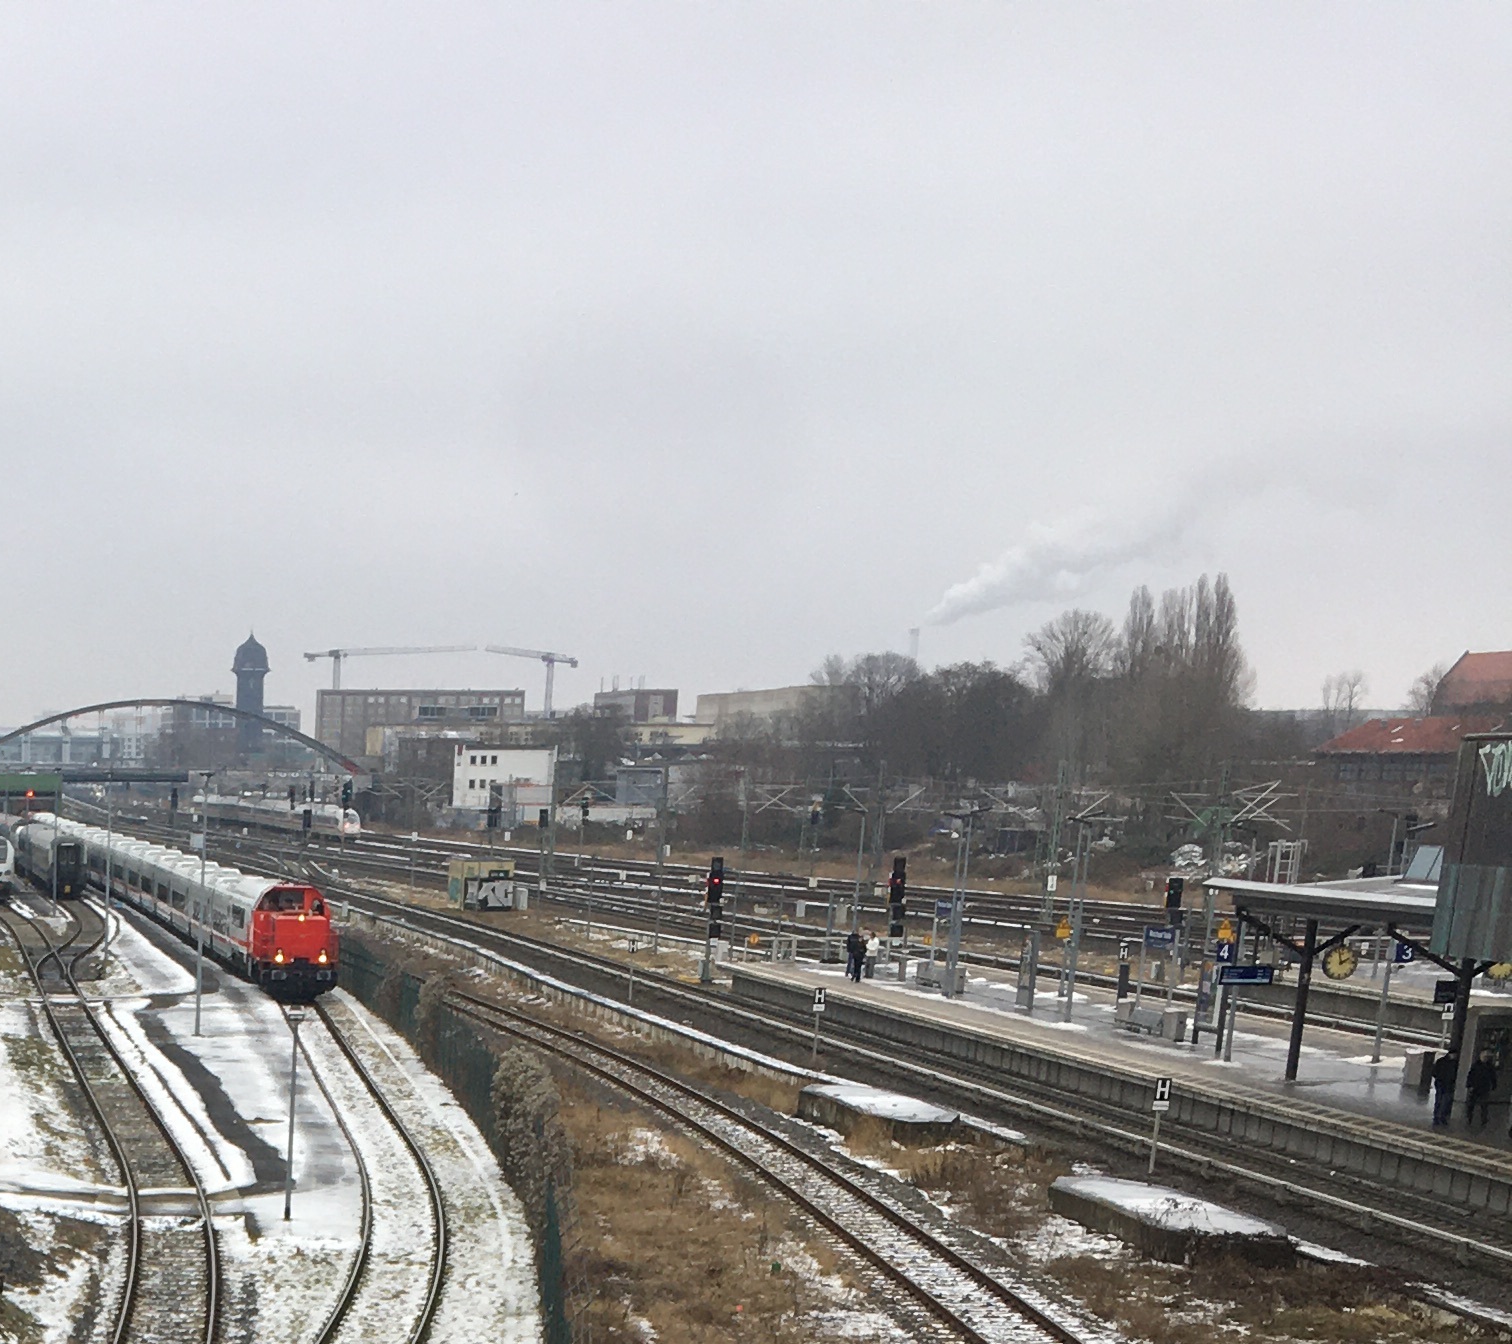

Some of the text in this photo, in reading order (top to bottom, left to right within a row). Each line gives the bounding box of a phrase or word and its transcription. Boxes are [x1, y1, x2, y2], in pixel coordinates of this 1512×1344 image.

[1119, 947, 1129, 959] H
[1219, 944, 1230, 960] 4
[1401, 944, 1413, 960] 3
[814, 989, 825, 1003] H
[1155, 1079, 1171, 1100] H
